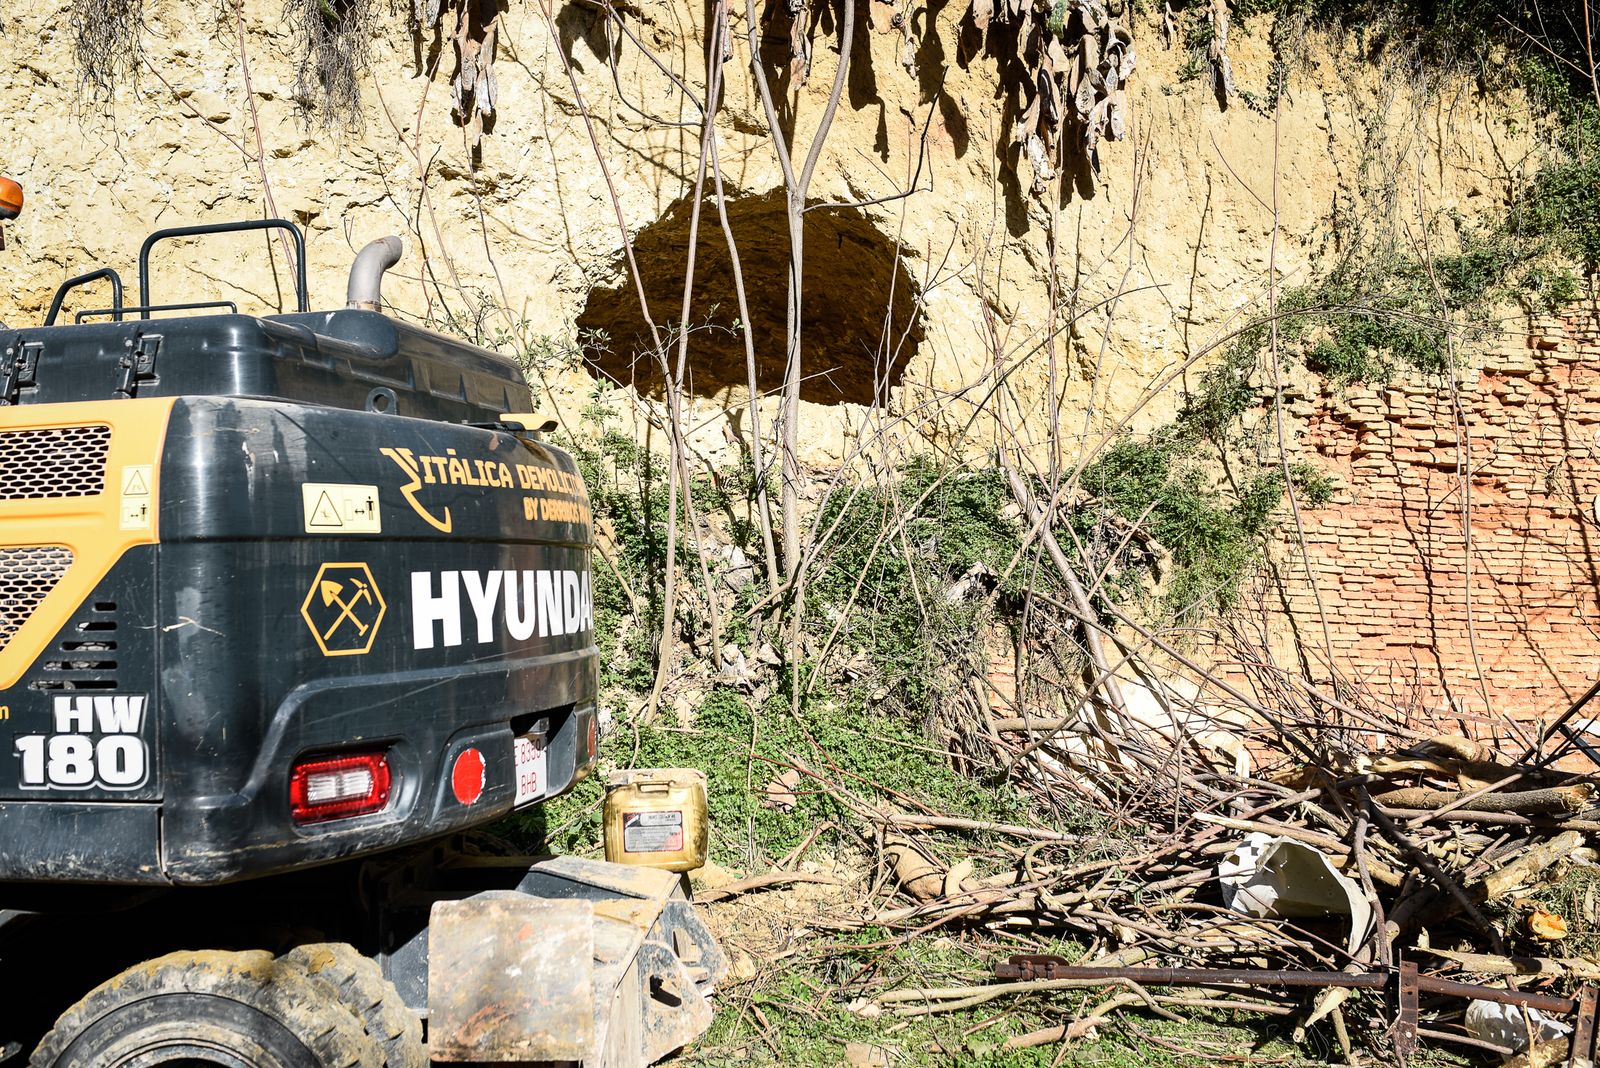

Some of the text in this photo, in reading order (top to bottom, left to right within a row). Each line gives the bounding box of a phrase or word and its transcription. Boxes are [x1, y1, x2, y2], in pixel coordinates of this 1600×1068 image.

[523, 496, 538, 520] BY
[411, 570, 593, 649] HYUNDAI
[54, 696, 145, 733] HW
[15, 735, 145, 786] 180
[521, 771, 537, 796] BHB
